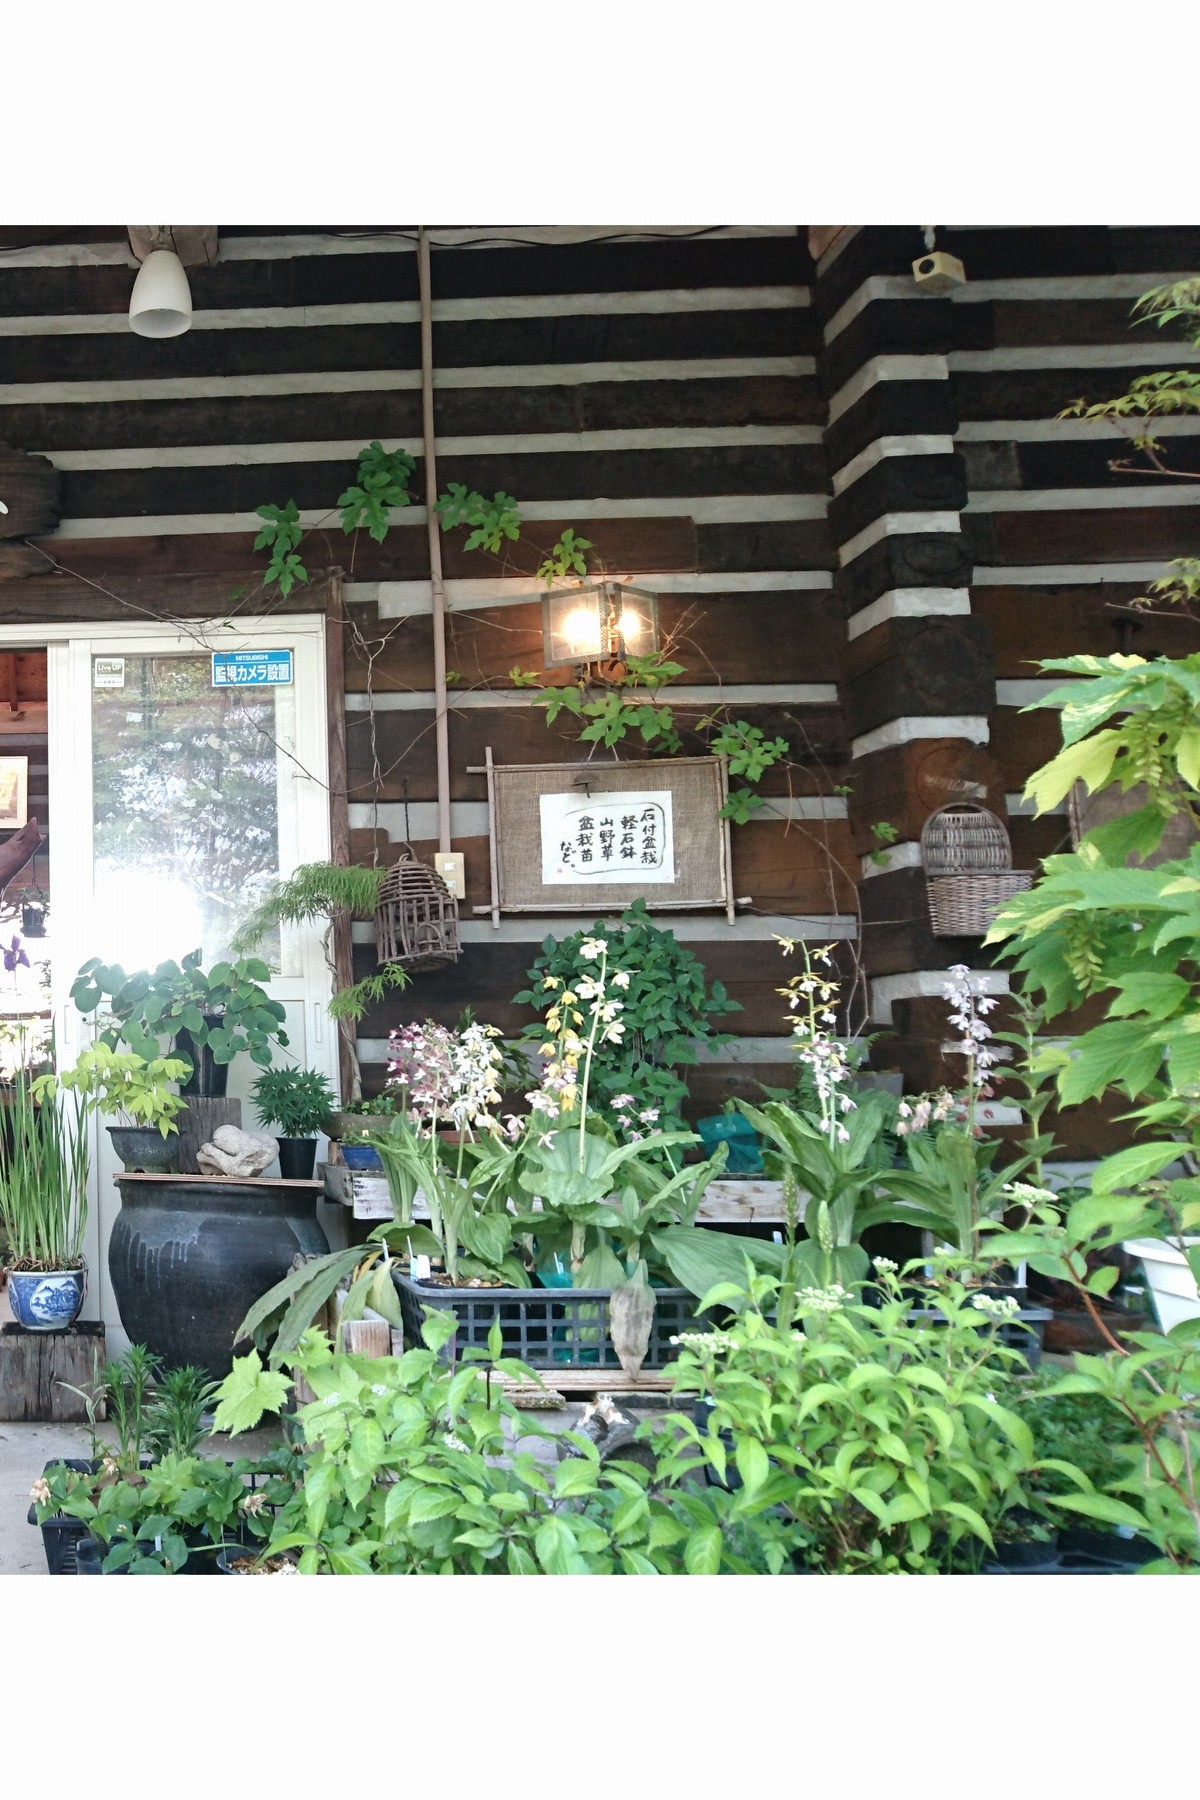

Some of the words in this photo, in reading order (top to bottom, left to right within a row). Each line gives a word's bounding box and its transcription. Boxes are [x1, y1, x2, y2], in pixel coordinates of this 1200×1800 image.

[215, 663, 290, 683] 監視カメラ設置
[576, 815, 595, 862] 盆栽苗
[599, 817, 616, 861] 山野草
[619, 815, 638, 859] 軽石鉢
[640, 808, 658, 864] 石付盆栽
